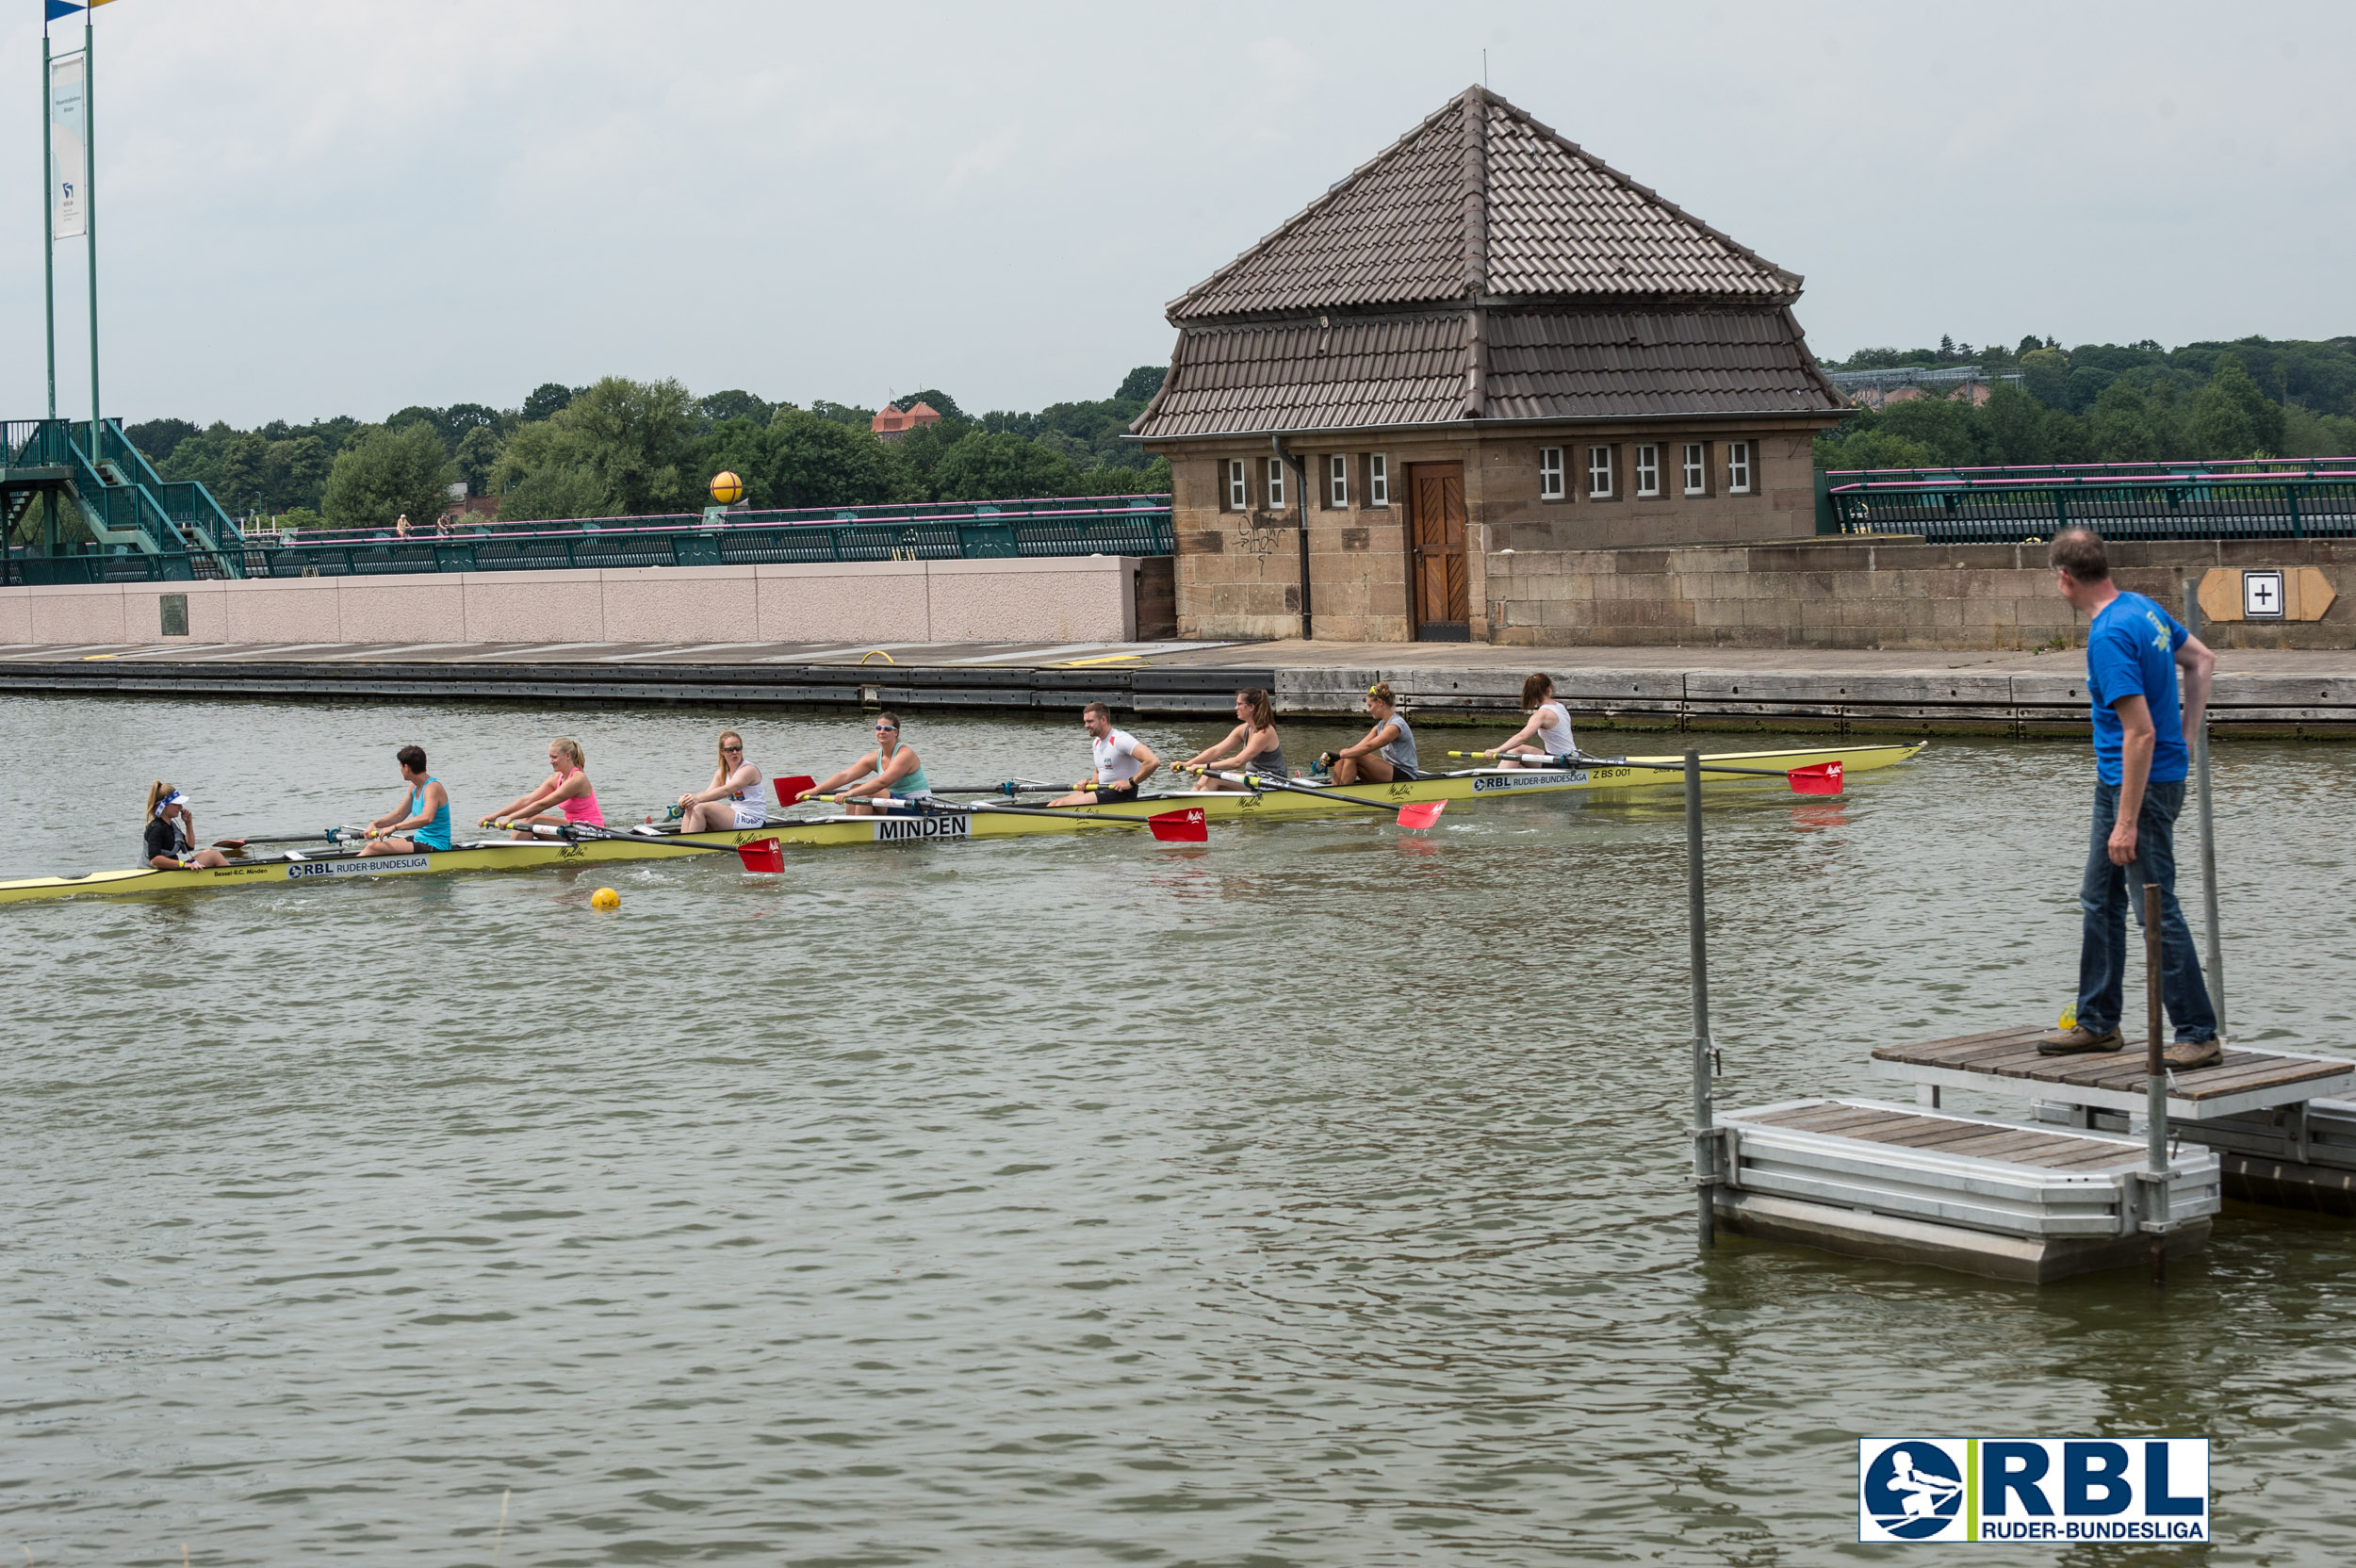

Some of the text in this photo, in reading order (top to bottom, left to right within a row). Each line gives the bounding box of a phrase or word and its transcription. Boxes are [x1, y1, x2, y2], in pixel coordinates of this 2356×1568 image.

[1486, 774, 1587, 788] RBL RUDER-BUNDESLIGA
[1593, 768, 1630, 779] Z BS 001
[879, 815, 966, 840] MINDEN
[304, 858, 427, 875] RBL RUDER-BUNDESLIGA
